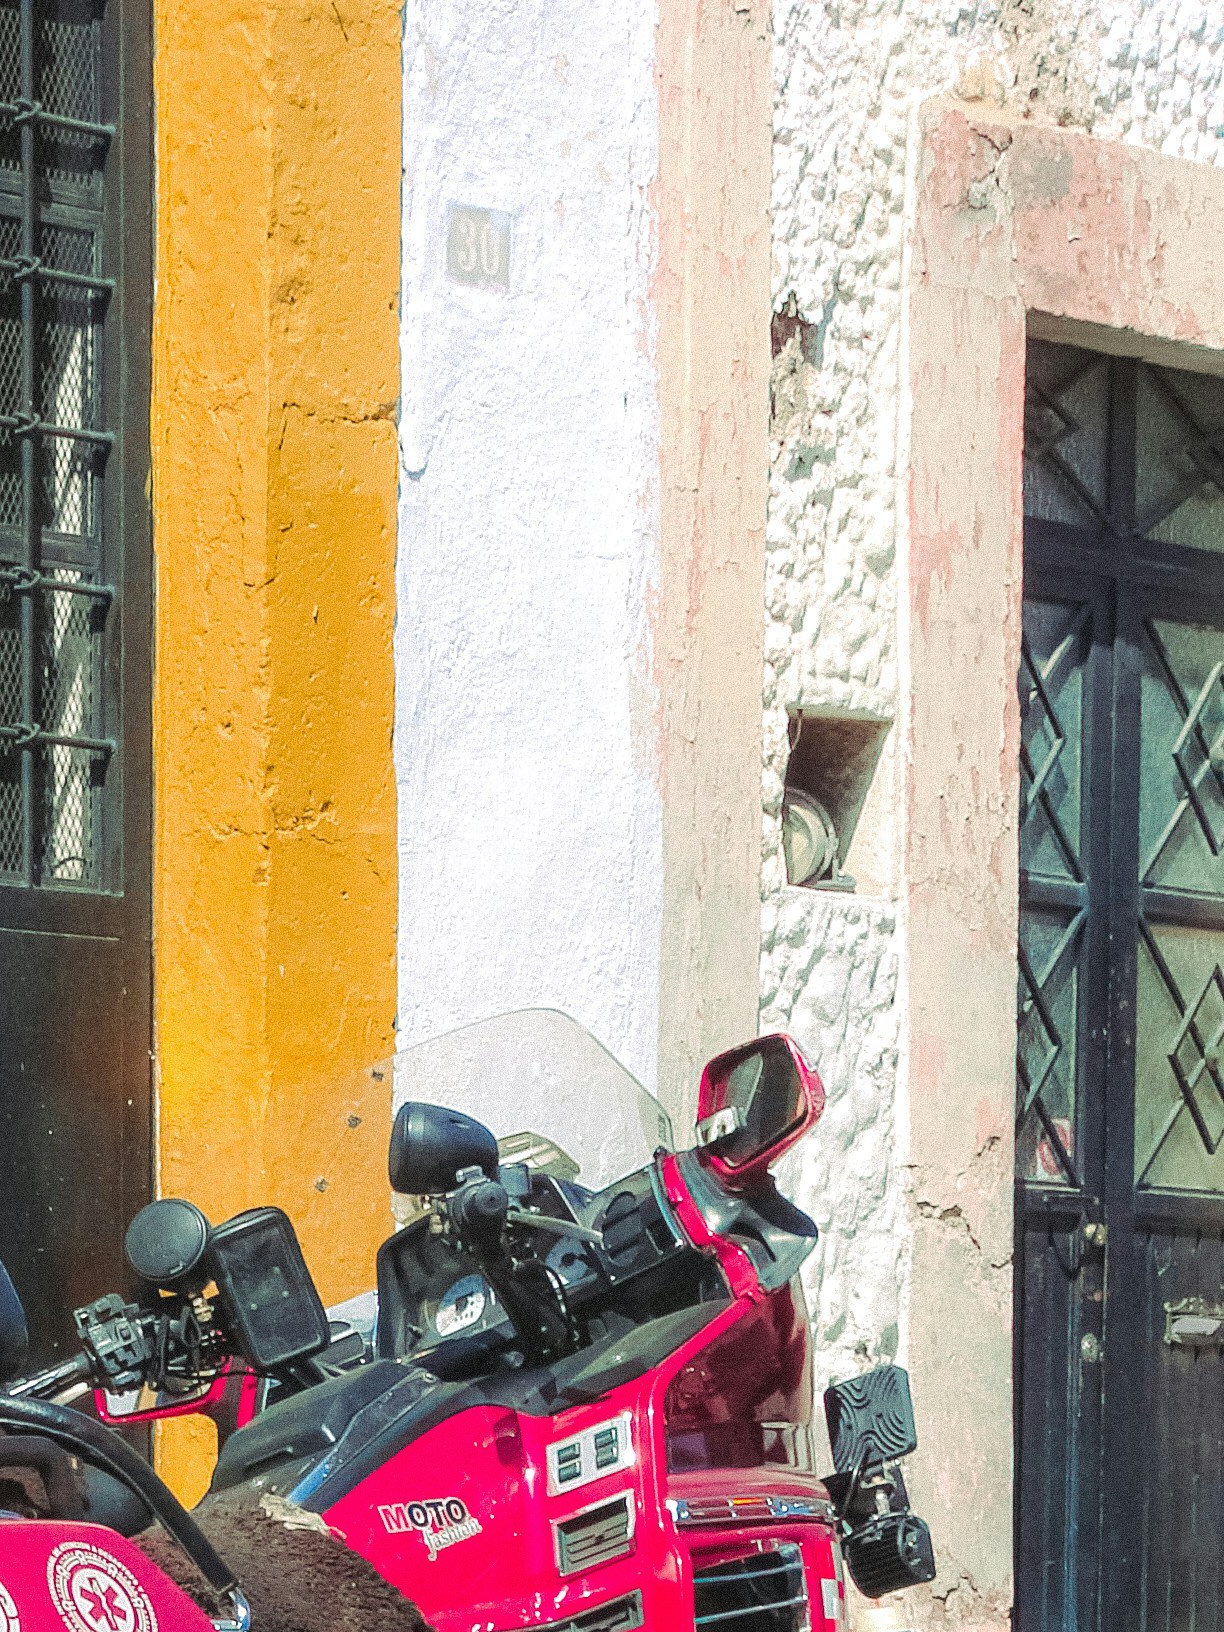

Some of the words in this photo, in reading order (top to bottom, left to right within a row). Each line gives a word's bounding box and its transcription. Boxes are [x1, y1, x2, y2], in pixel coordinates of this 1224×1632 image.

[457, 218, 499, 275] 30
[377, 1496, 469, 1534] MOTO
[423, 1518, 482, 1561] fashion
